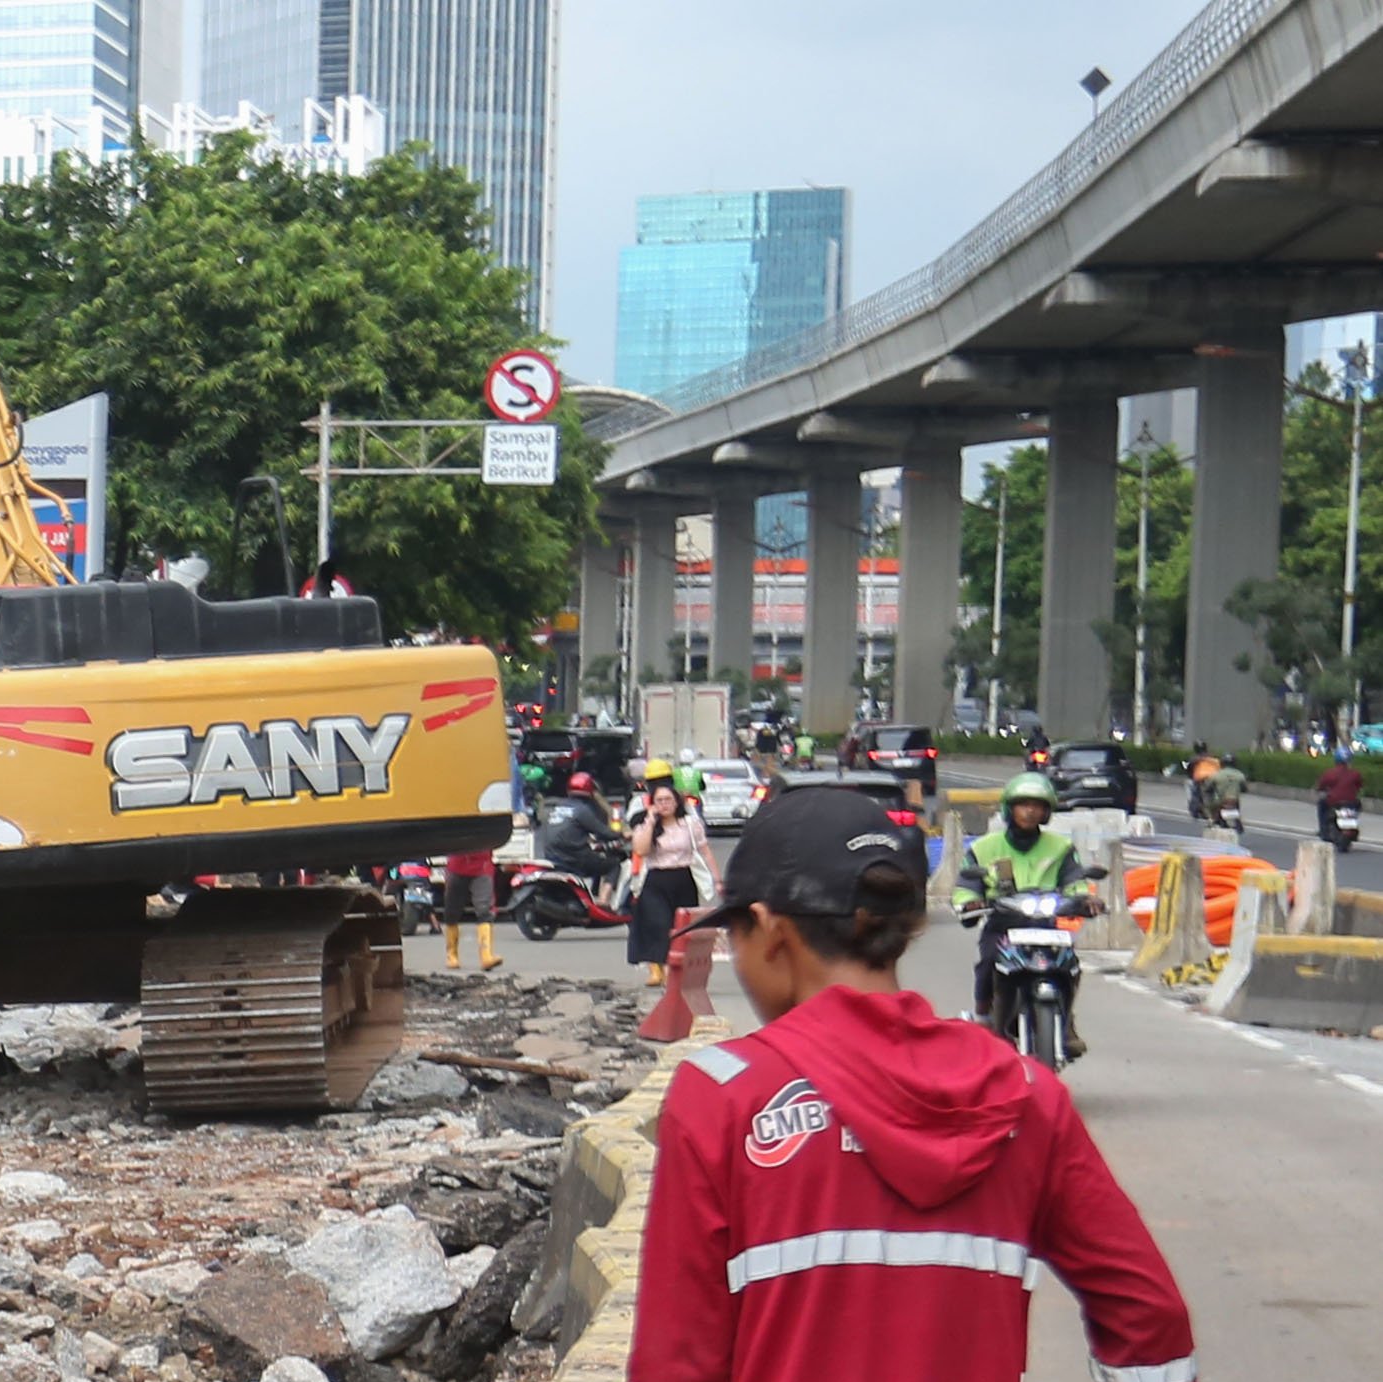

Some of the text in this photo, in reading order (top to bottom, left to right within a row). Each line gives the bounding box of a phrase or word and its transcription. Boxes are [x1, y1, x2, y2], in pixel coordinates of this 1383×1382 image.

[489, 430, 553, 446] Sampai
[490, 448, 548, 462] Rambu
[488, 464, 548, 479] Berikut
[105, 712, 412, 813] SANY
[755, 1103, 826, 1142] CMB
